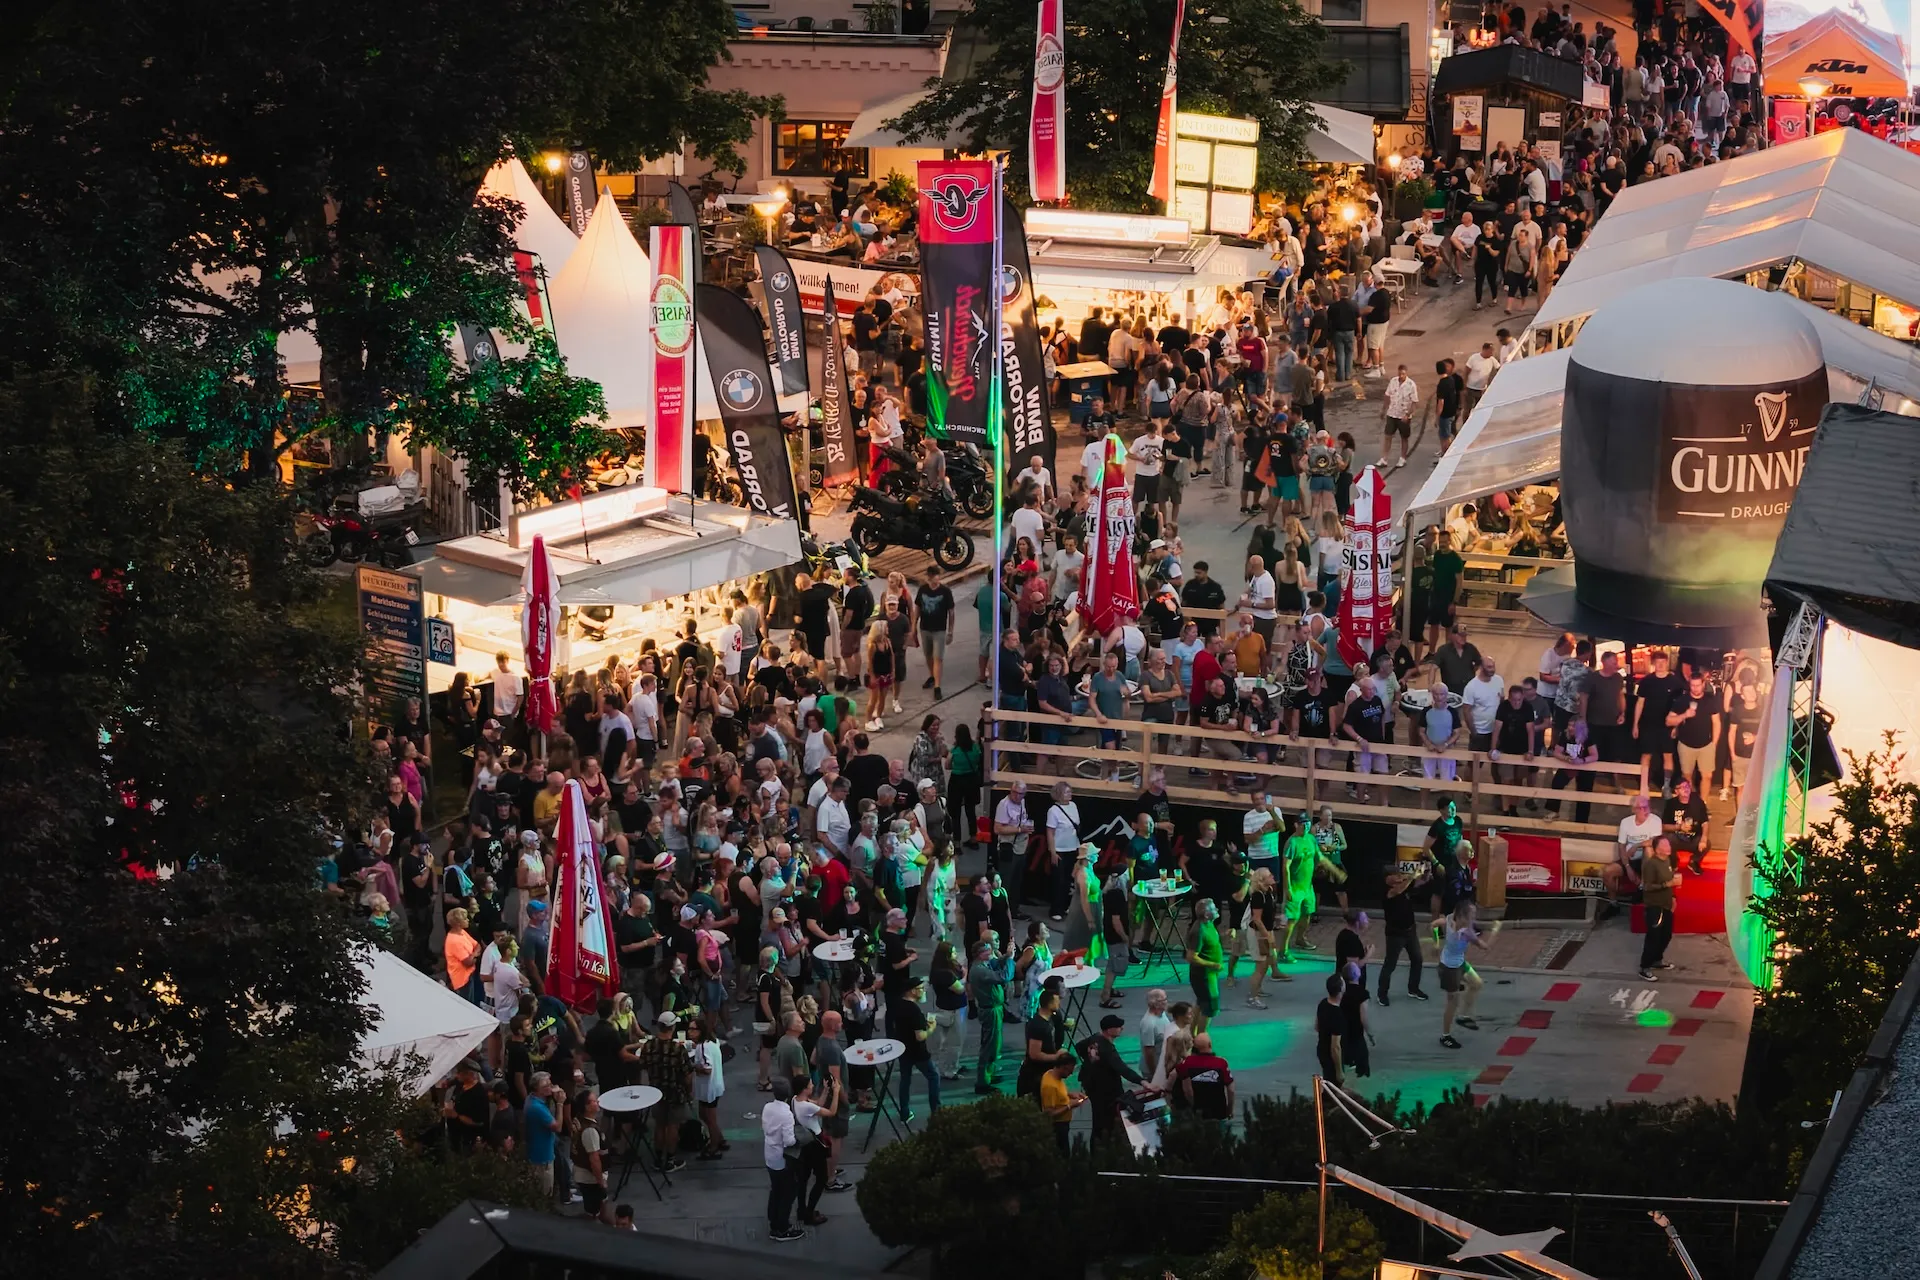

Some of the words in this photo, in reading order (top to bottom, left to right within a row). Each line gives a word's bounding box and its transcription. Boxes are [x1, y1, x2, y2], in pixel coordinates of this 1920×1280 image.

[1805, 59, 1868, 74] KTM
[1177, 163, 1196, 172] OTEL
[1740, 424, 1752, 434] 17
[1789, 418, 1799, 429] 59
[1671, 446, 1810, 493] GUINNE
[363, 576, 405, 591] NEUKIRCHEN
[443, 642, 452, 652] 20
[434, 652, 451, 663] Zone
[1510, 866, 1532, 874] Kaiser
[1508, 873, 1531, 881] Kaiser
